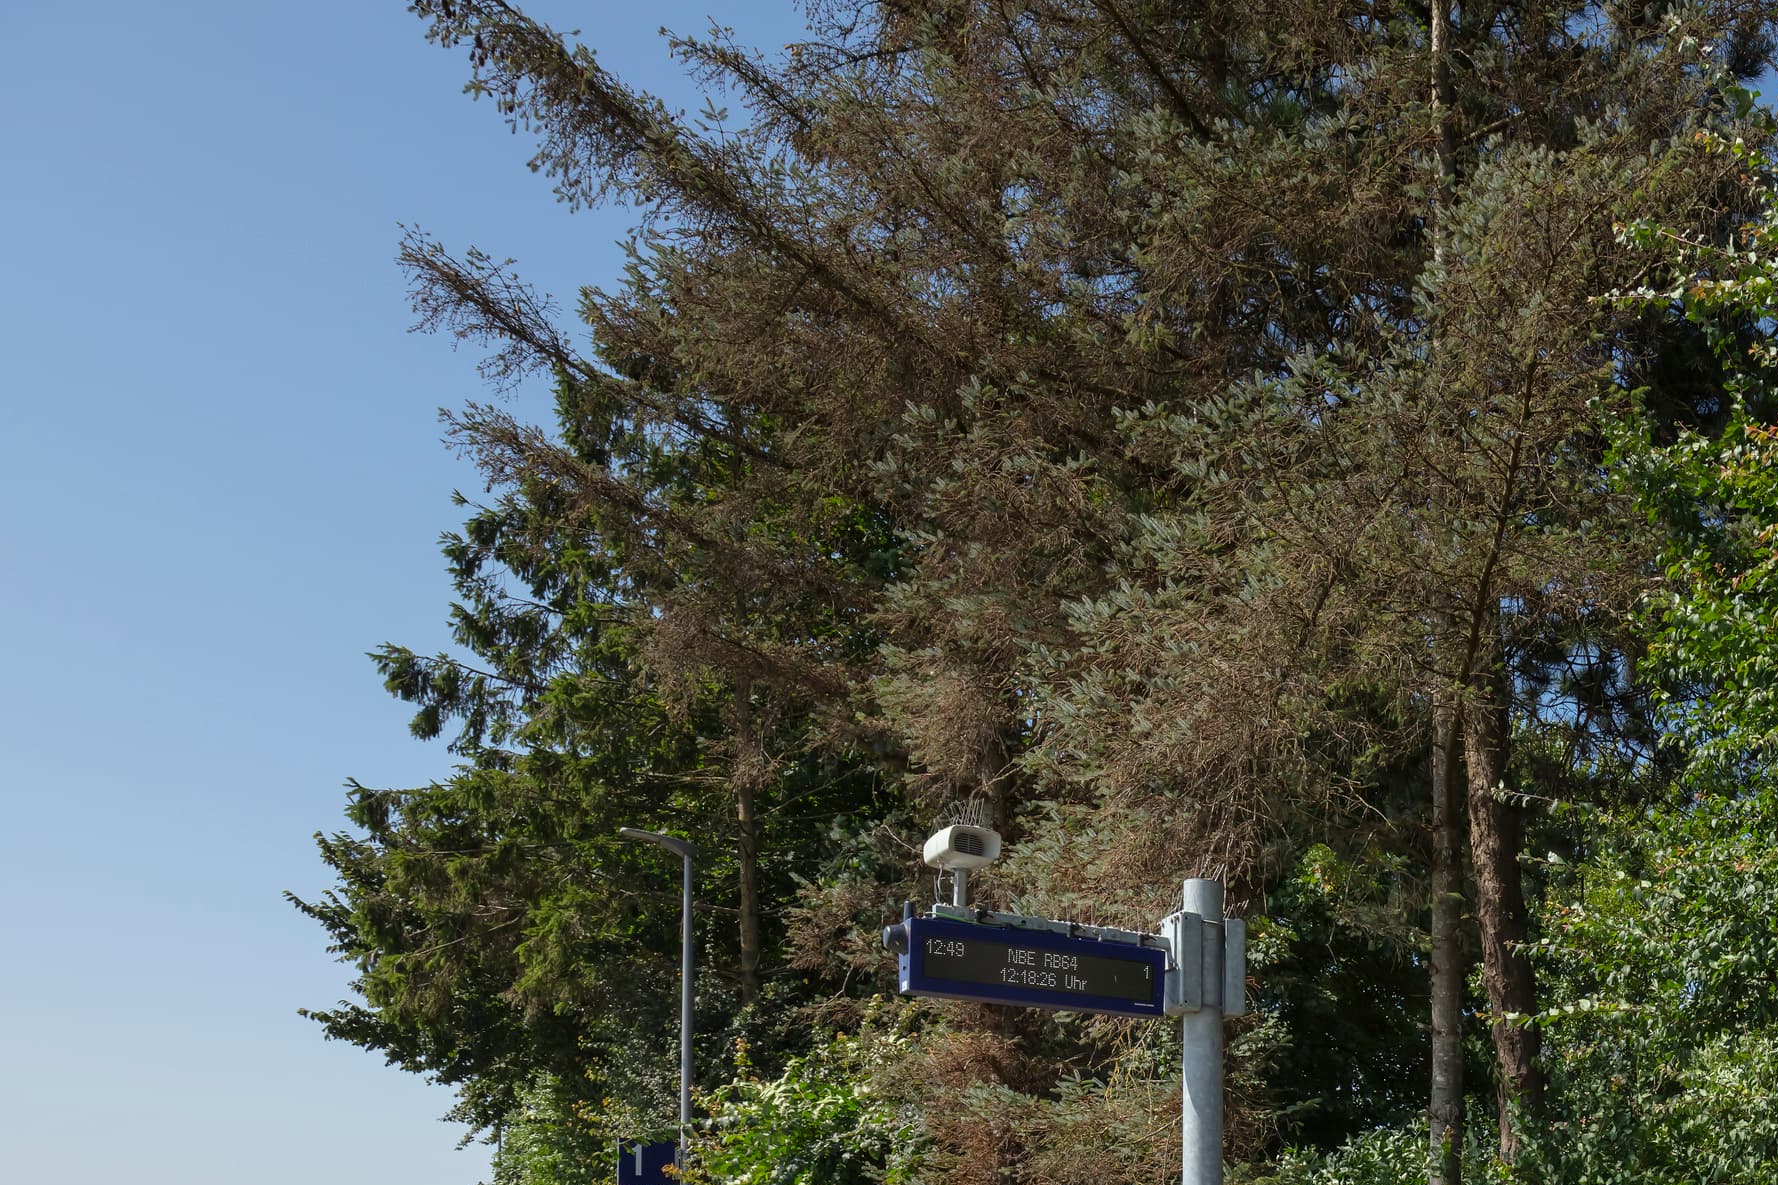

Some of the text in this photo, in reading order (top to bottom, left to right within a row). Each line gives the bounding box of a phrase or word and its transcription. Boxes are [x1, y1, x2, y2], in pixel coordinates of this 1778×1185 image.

[925, 938, 965, 957] 12:49
[1007, 948, 1079, 971] NBE RB64
[1000, 967, 1088, 991] 12:18:26 Uhr
[1143, 965, 1150, 980] 1
[632, 1143, 642, 1176] 1
